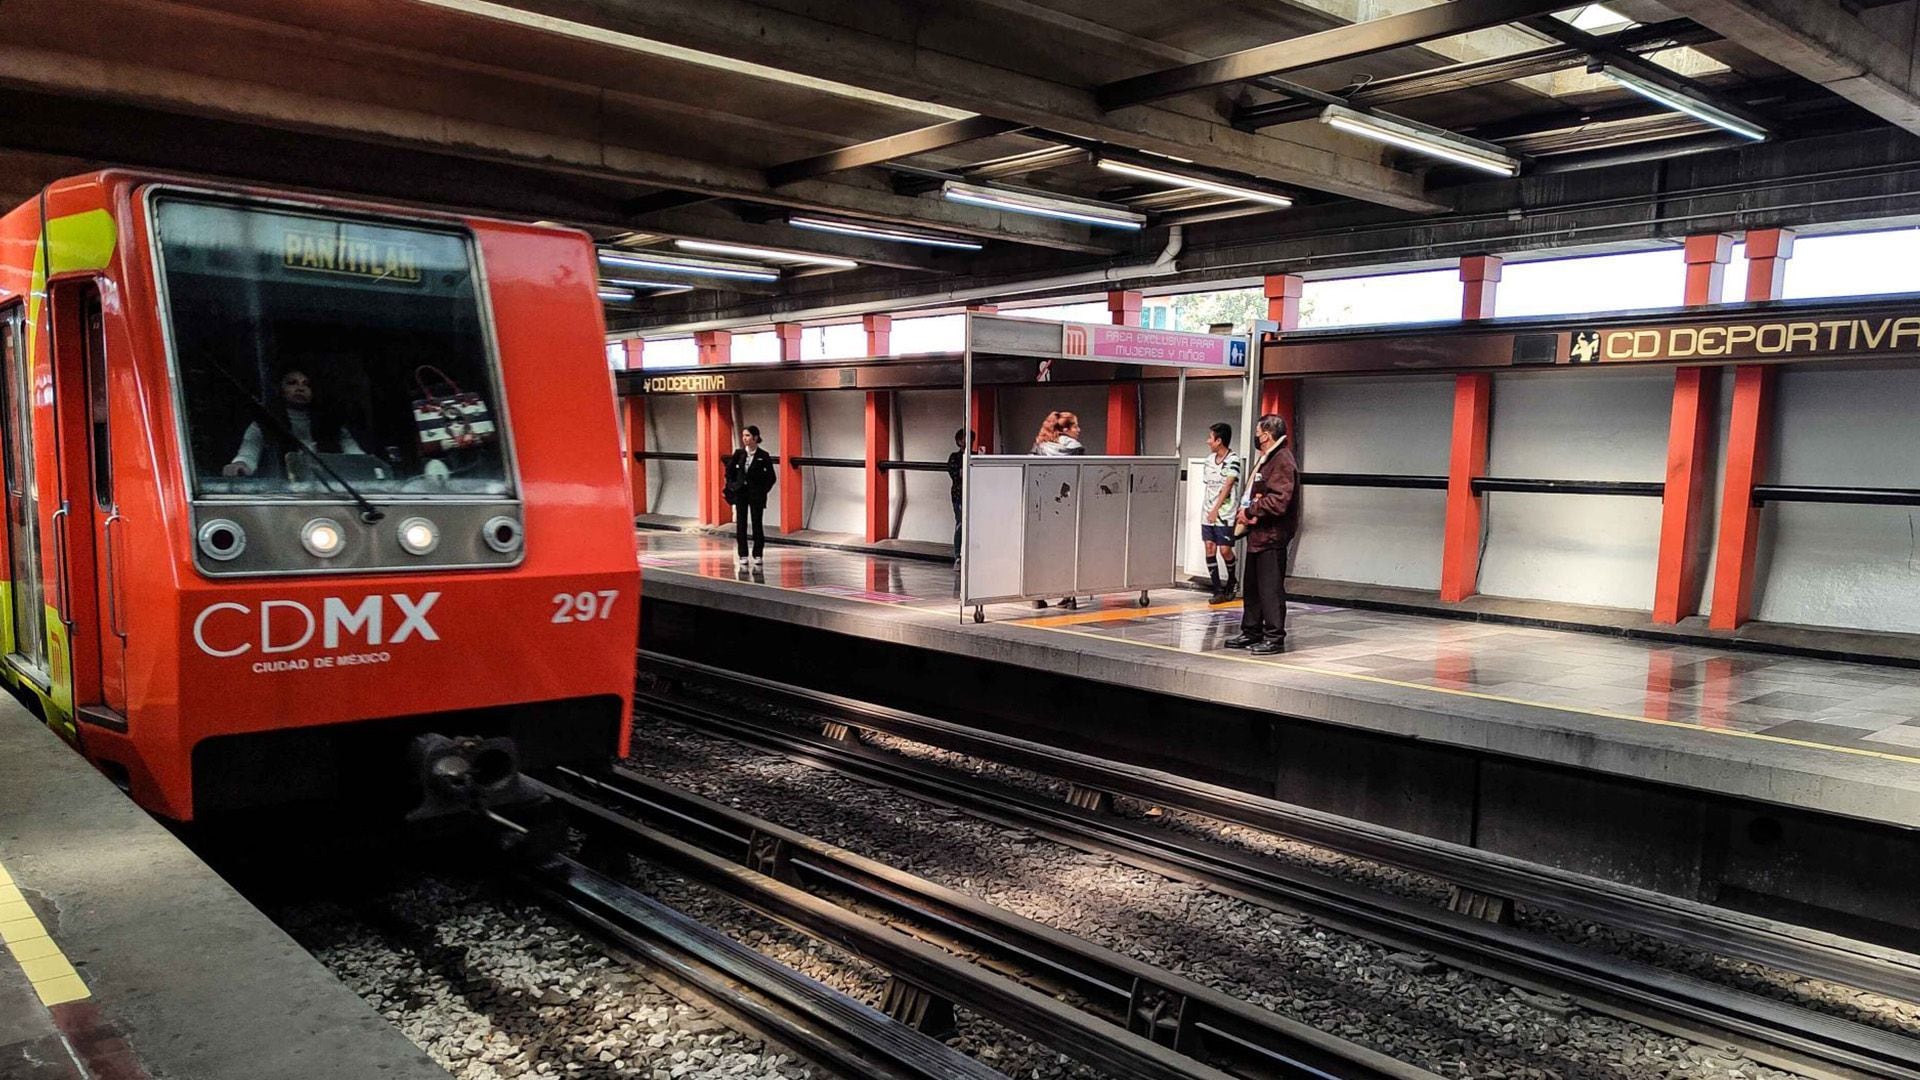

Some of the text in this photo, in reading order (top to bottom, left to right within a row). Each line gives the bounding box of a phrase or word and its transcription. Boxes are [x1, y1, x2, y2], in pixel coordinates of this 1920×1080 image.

[1606, 317, 1920, 359] CD DEPORTIVA
[1115, 345, 1206, 361] MUJERES Y NIÑOS
[651, 375, 725, 391] CD DEPORTIVA
[551, 590, 619, 624] 297
[193, 592, 442, 657] CDMX
[252, 659, 309, 673] CIUDAD
[314, 657, 334, 668] DE
